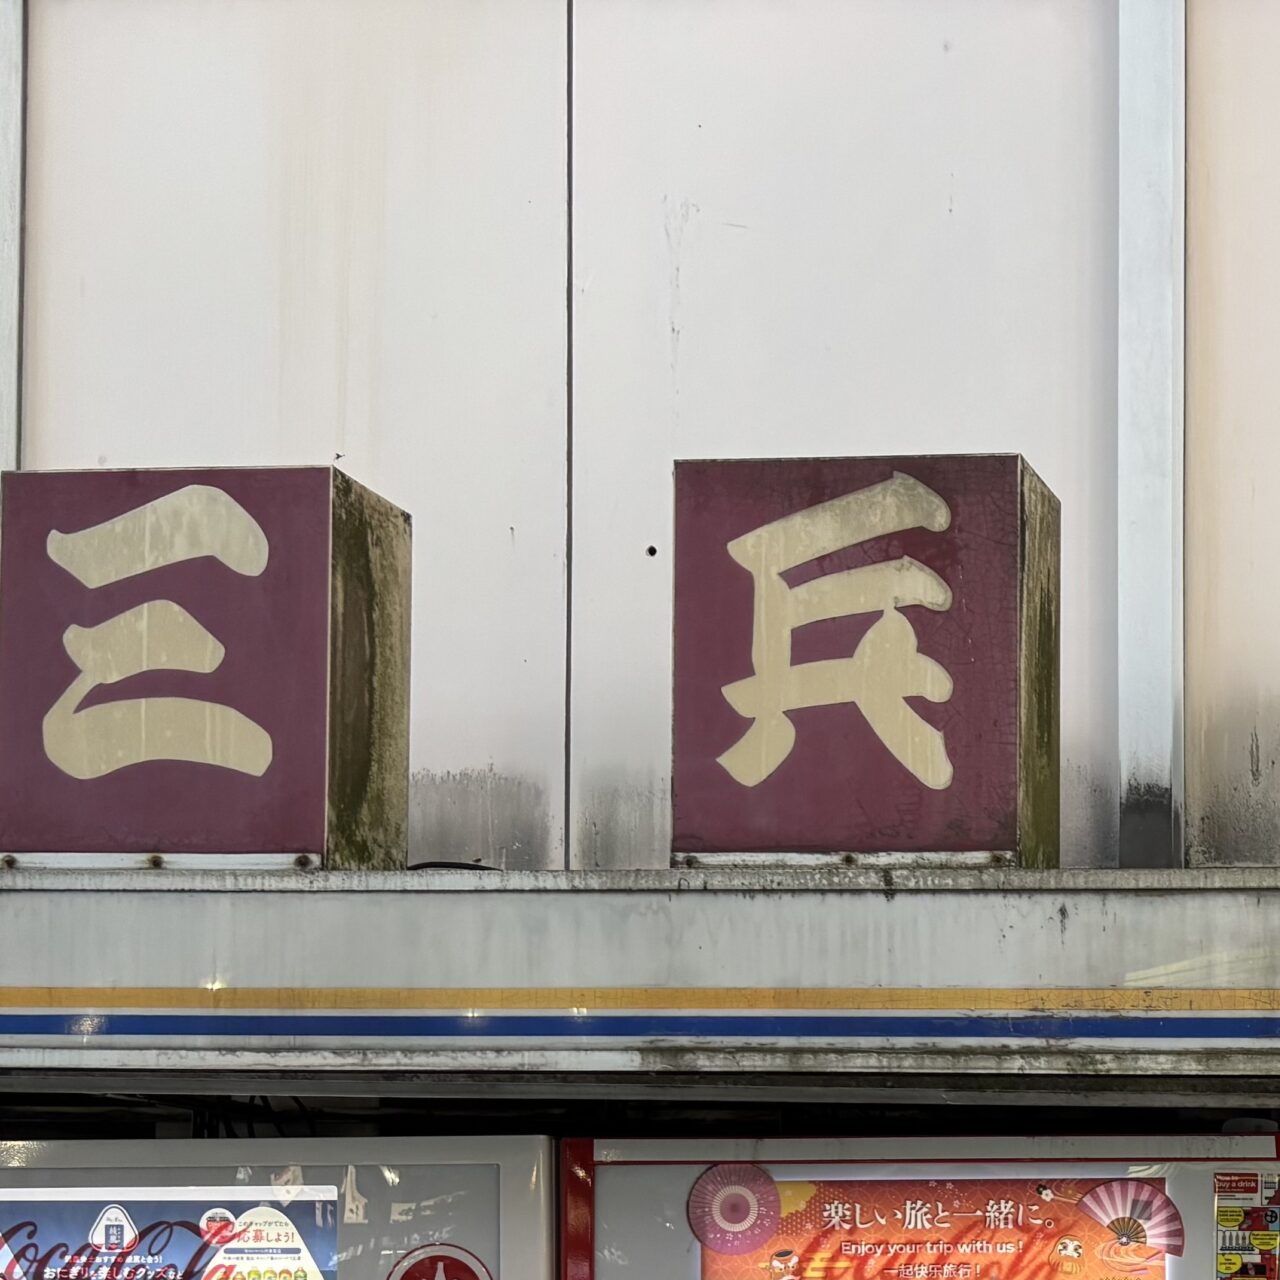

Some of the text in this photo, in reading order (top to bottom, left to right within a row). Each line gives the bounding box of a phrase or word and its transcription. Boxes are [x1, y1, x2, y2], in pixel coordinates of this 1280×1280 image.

[715, 468, 954, 792] 兵
[821, 1200, 1057, 1231] 楽しい旅と一緒に。
[841, 1241, 885, 1256] Enjoy
[887, 1243, 923, 1256] your
[925, 1241, 954, 1256] trip
[957, 1241, 993, 1254] with
